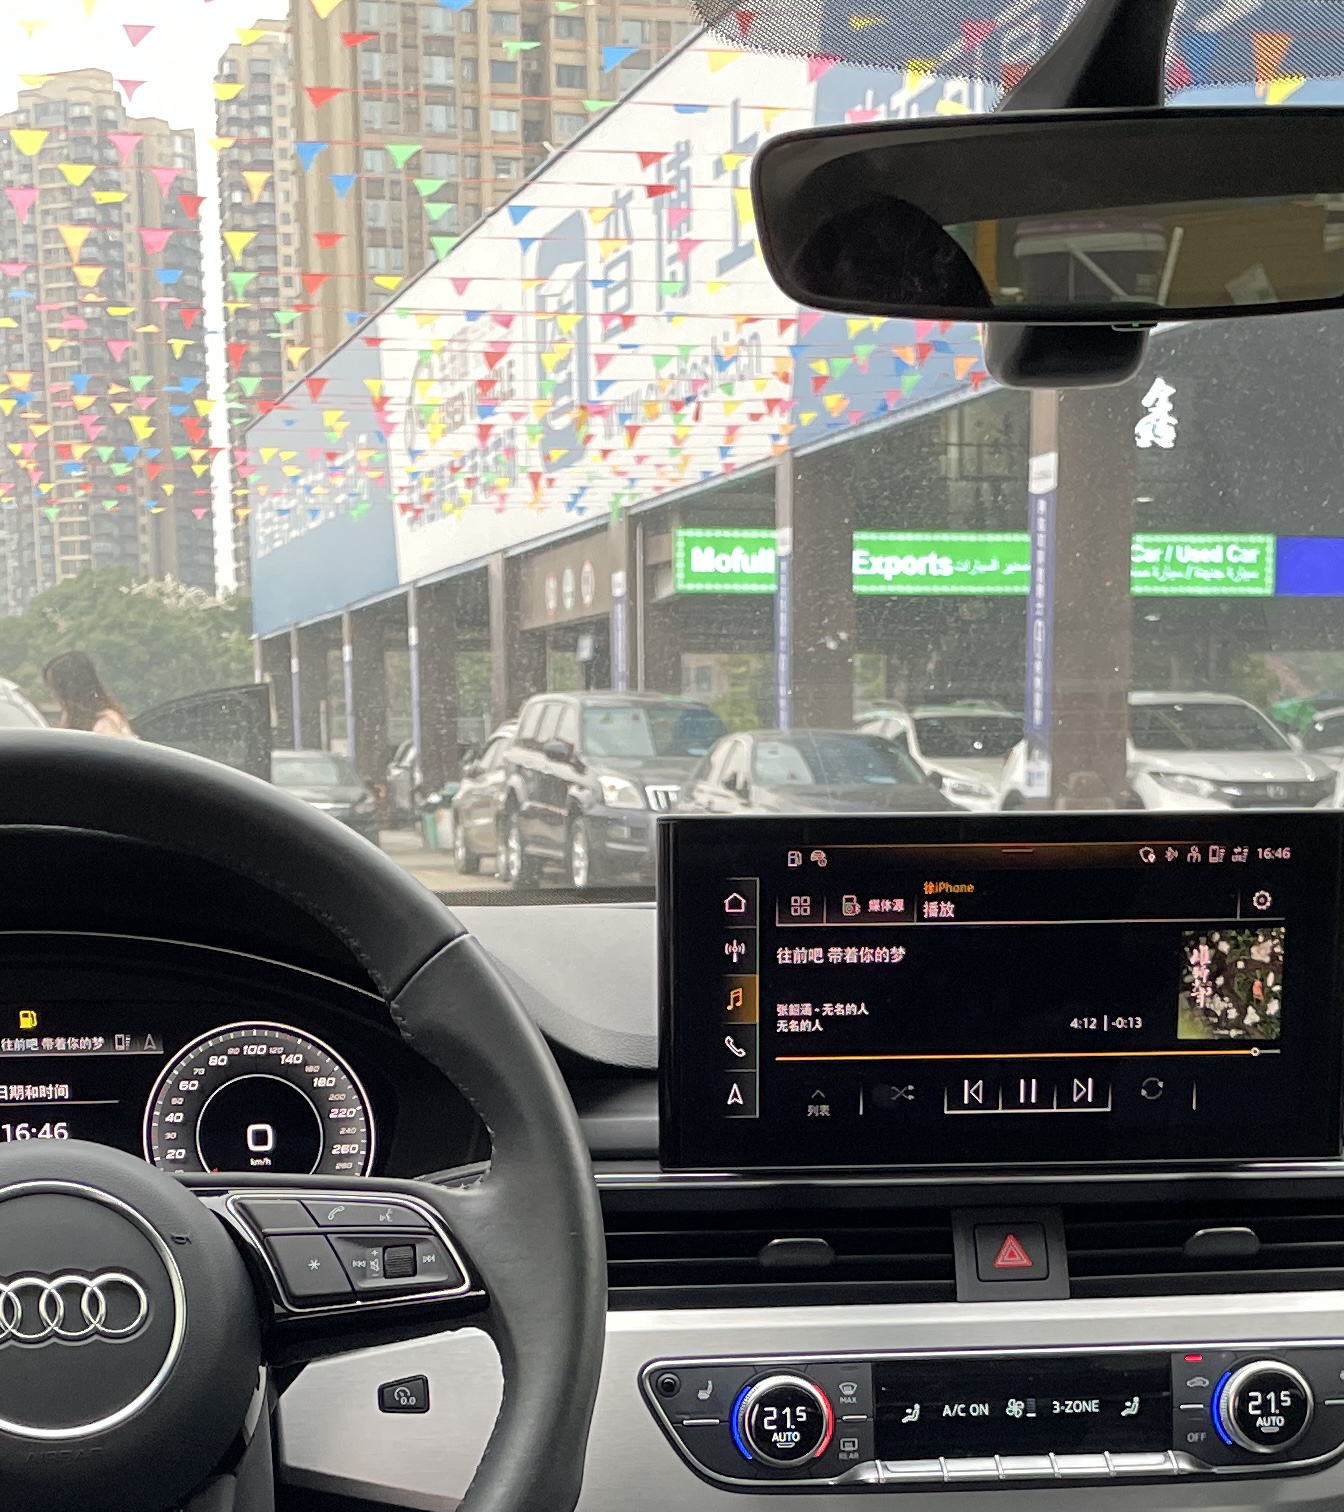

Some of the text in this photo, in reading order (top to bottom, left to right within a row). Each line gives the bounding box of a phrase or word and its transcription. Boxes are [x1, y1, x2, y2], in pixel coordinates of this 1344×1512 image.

[1176, 544, 1224, 563] Used
[1226, 544, 1260, 563] Car
[852, 549, 954, 581] Exports
[1257, 847, 1291, 860] 16:46
[922, 900, 955, 918] 播放
[776, 946, 906, 965] 往前吧 带着你的梦
[822, 1003, 869, 1016] 无名的人
[776, 1019, 824, 1033] 无名的人
[1069, 1016, 1143, 1029] 4:12 -0:13
[1, 1036, 105, 1052] 往前吧 带着你的梦
[242, 1044, 268, 1056] 100
[208, 1054, 228, 1066] 80
[280, 1053, 303, 1065] 140
[178, 1079, 199, 1092] 60
[164, 1112, 184, 1123] 40
[328, 1107, 357, 1119] 220
[807, 1104, 831, 1118] 列表
[1, 1122, 69, 1143] 16:46
[165, 1148, 186, 1160] 20
[331, 1143, 359, 1155] 260
[1052, 1399, 1100, 1414] 3-ZONE
[1247, 1390, 1292, 1416] 21.5
[941, 1402, 990, 1418] A/C ON
[763, 1405, 807, 1431] 21.5
[1255, 1415, 1285, 1428] AUTO
[771, 1431, 801, 1443] AUTO
[1186, 1431, 1206, 1443] OFF
